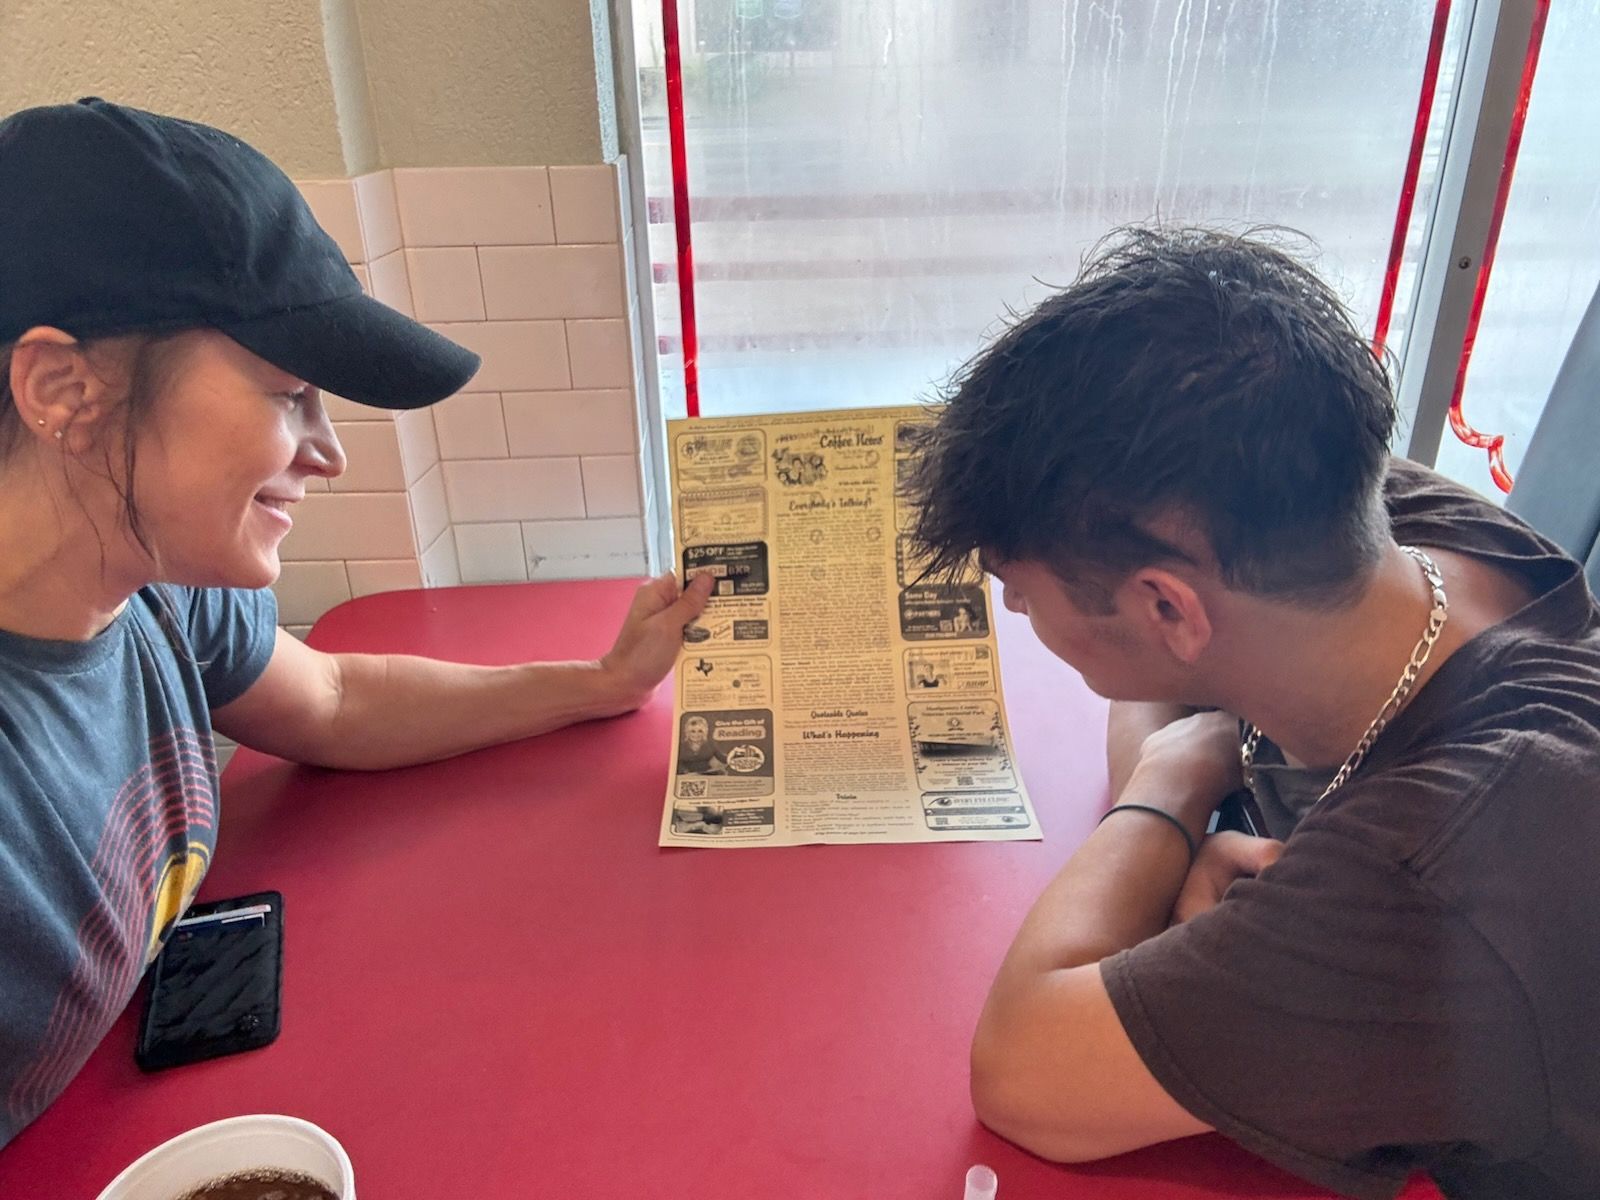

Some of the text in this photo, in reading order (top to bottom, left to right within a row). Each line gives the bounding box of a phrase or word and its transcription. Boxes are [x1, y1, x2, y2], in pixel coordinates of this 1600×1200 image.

[820, 434, 853, 449] Coffee
[856, 433, 884, 446] News
[688, 548, 705, 560] $25
[706, 546, 725, 557] OFF
[904, 591, 938, 600] Same Day
[718, 728, 763, 738] Reading
[802, 729, 880, 740] What's Happening
